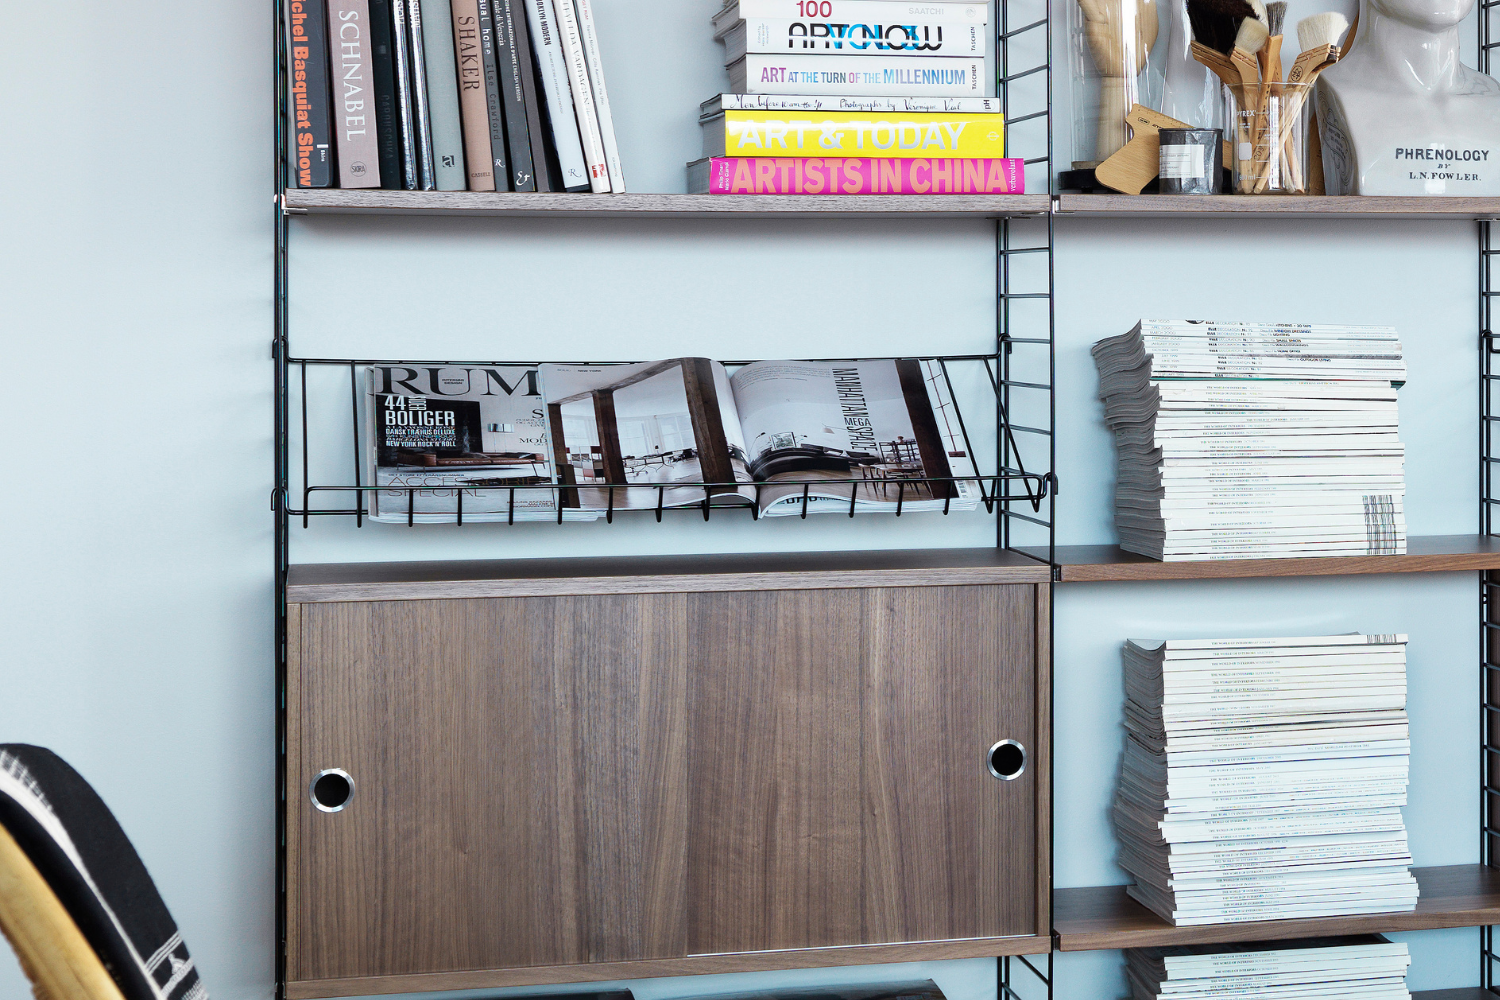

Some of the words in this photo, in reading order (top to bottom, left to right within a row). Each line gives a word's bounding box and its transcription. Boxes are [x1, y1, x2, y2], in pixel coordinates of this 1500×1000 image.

[291, 0, 308, 41] chel
[796, 0, 832, 18] 100
[481, 28, 491, 54] home
[497, 21, 506, 46] Venezia
[540, 21, 552, 45] MODERN
[458, 16, 479, 91] SHAKER
[293, 47, 311, 128] Basquiat
[339, 11, 365, 141] SCHNABEL
[486, 64, 494, 86] Ilse
[761, 67, 786, 83] ART
[788, 71, 799, 83] AT
[801, 71, 819, 83] THE
[821, 72, 847, 83] TURN
[849, 72, 861, 83] OF
[863, 72, 881, 84] THE
[883, 69, 966, 85] MILLENNIUM
[489, 94, 501, 139] Crawford
[886, 98, 896, 112] by
[737, 120, 811, 149] ART
[818, 120, 845, 149] &
[849, 120, 967, 150] TODAY
[298, 133, 313, 186] Show
[1395, 148, 1489, 161] PHRENOLOGY
[352, 165, 366, 173] SKIRA
[731, 158, 863, 193] ARTISTS
[871, 159, 901, 193] IN
[909, 158, 1008, 193] CHINA
[376, 366, 541, 396] RUM
[832, 368, 869, 417] MANHATTAN
[385, 395, 406, 410] 44
[385, 410, 455, 426] BOLIGER
[844, 417, 872, 427] MEGA
[846, 426, 878, 451] SPACE
[387, 488, 487, 498] SPECIAL
[388, 476, 551, 487] ACCESSORIES
